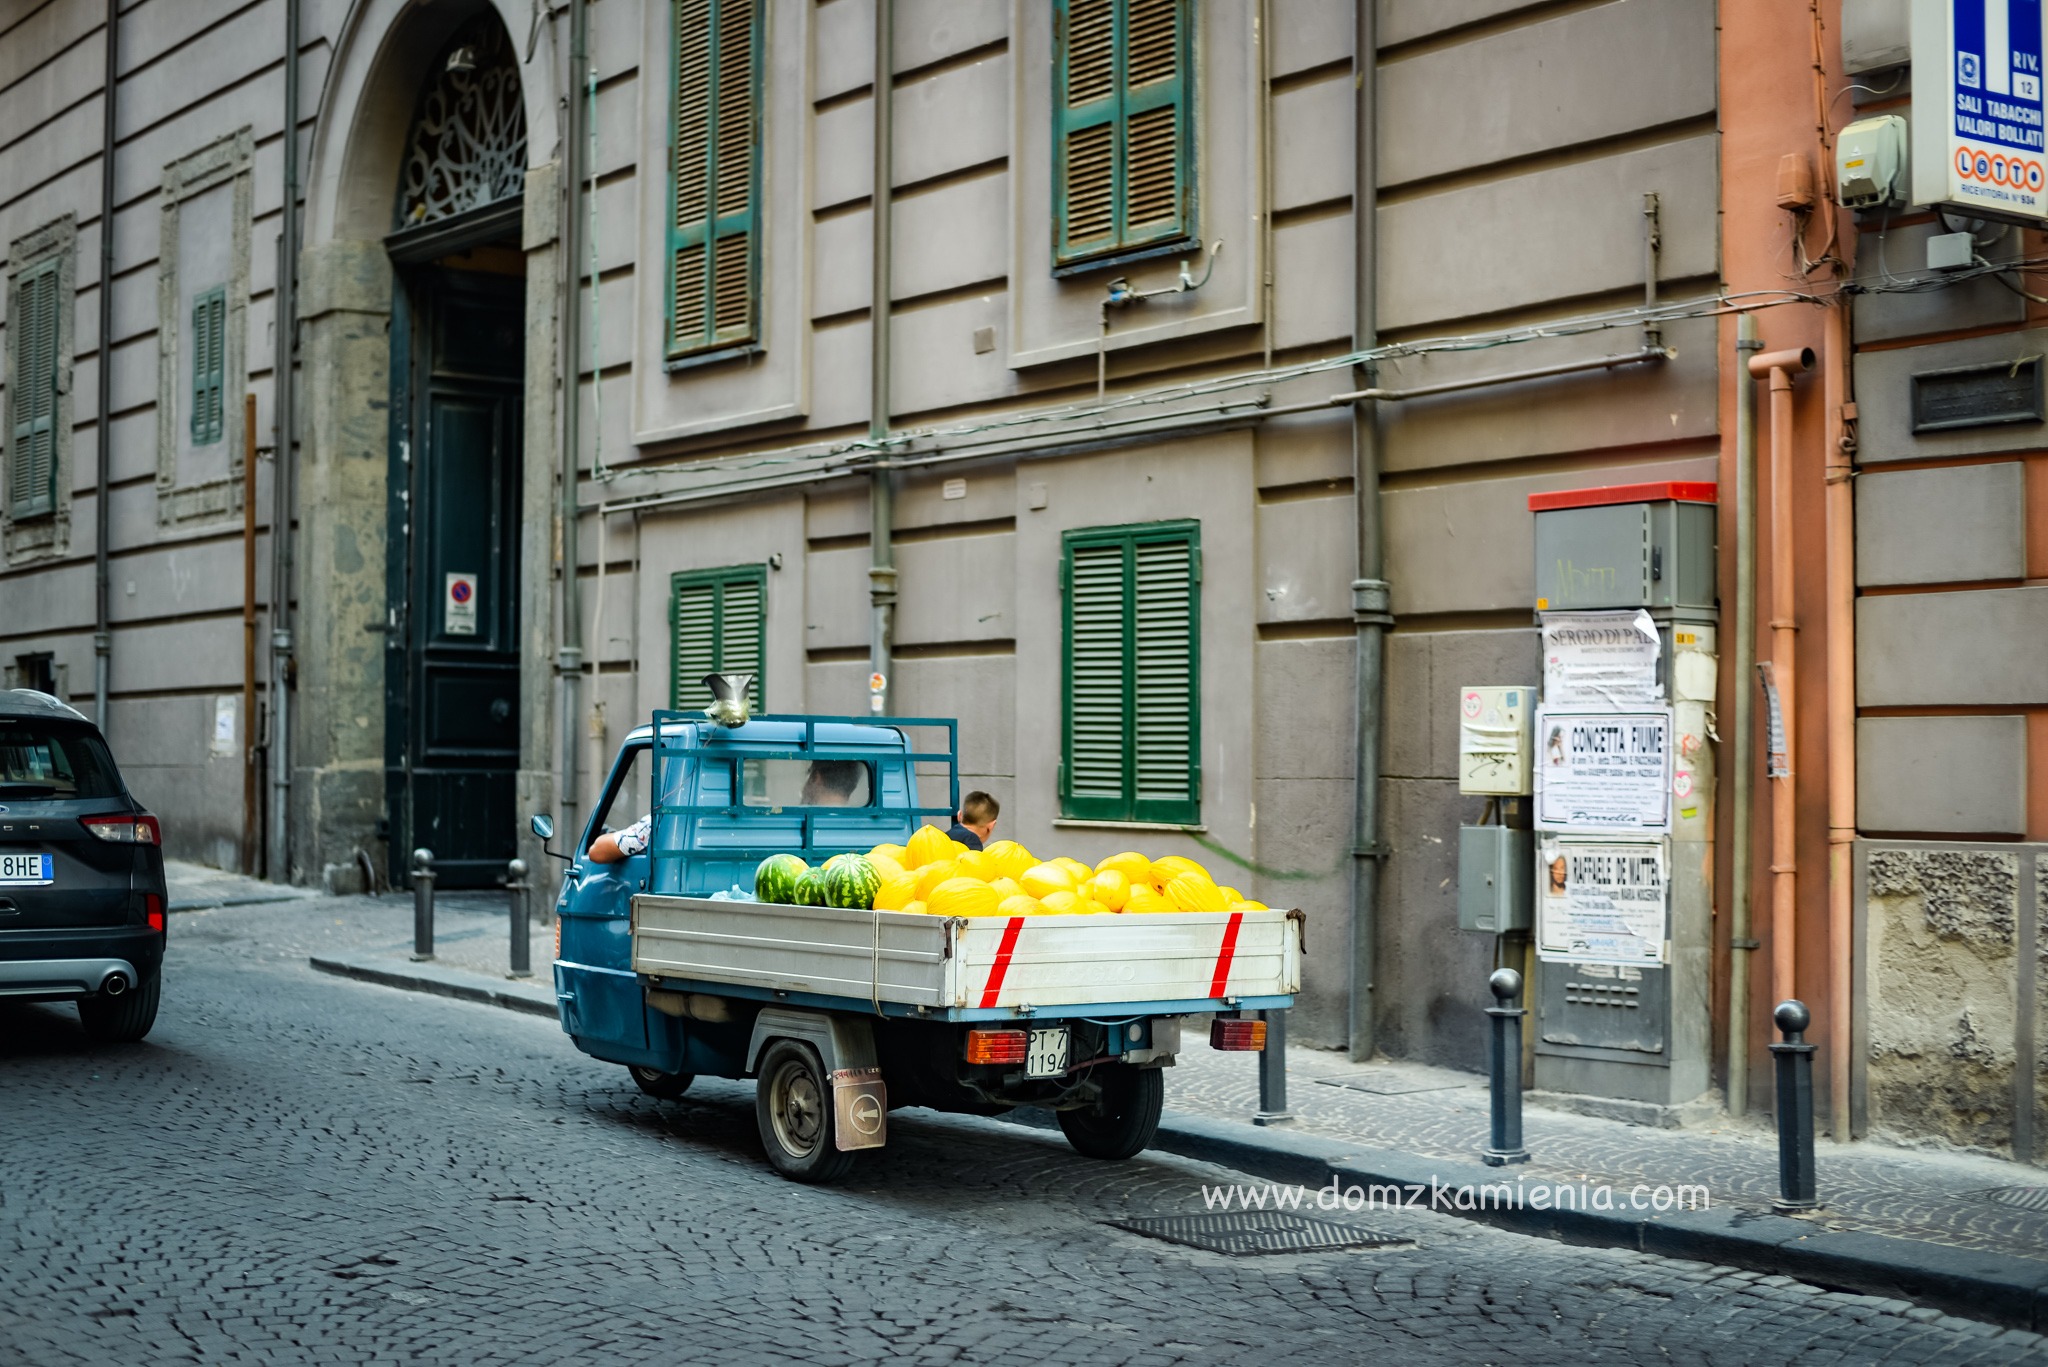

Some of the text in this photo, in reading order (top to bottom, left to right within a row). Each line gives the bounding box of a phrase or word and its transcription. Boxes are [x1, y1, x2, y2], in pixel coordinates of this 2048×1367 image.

[2013, 50, 2039, 72] RIV.
[2021, 81, 2033, 95] 12
[1957, 93, 2041, 126] SALI TABACCHI
[1957, 114, 2044, 148] VALORI BOLLATI
[1550, 628, 1602, 646] SERGIO
[1604, 628, 1621, 644] DI
[1572, 726, 1662, 753] CONCETTA FIUME
[3, 857, 39, 876] 8HE
[1573, 856, 1611, 884] RAFFAELE
[1616, 857, 1627, 885] DE
[1029, 1030, 1068, 1051] PT 7
